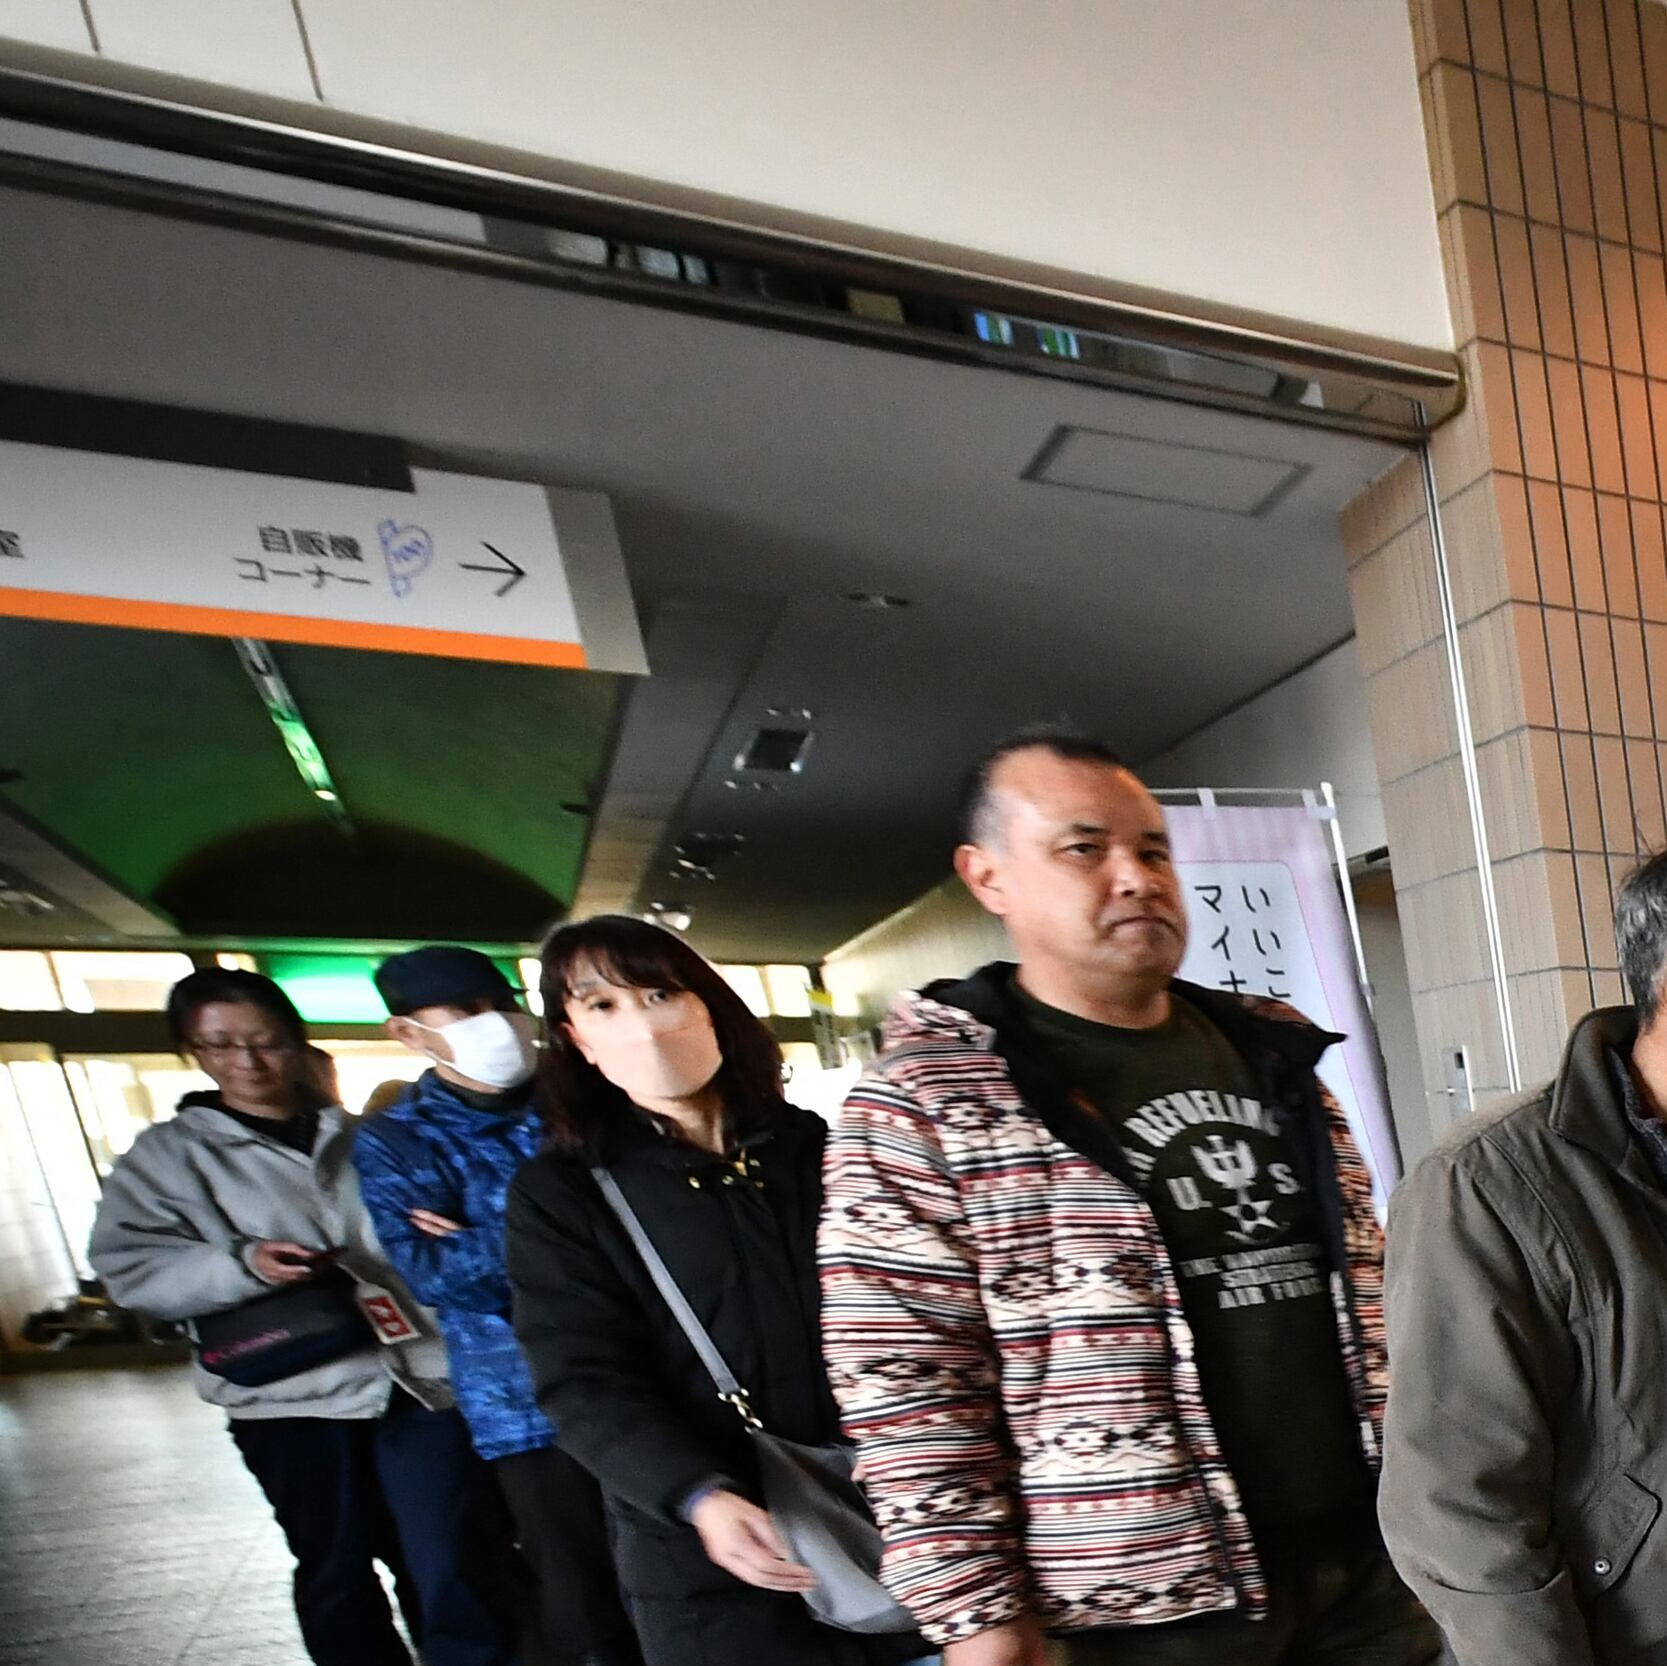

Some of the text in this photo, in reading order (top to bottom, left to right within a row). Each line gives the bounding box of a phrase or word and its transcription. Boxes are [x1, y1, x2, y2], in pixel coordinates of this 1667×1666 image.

[258, 525, 363, 562] 自販機
[234, 556, 371, 589] コーナー
[1166, 1176, 1213, 1211] U.
